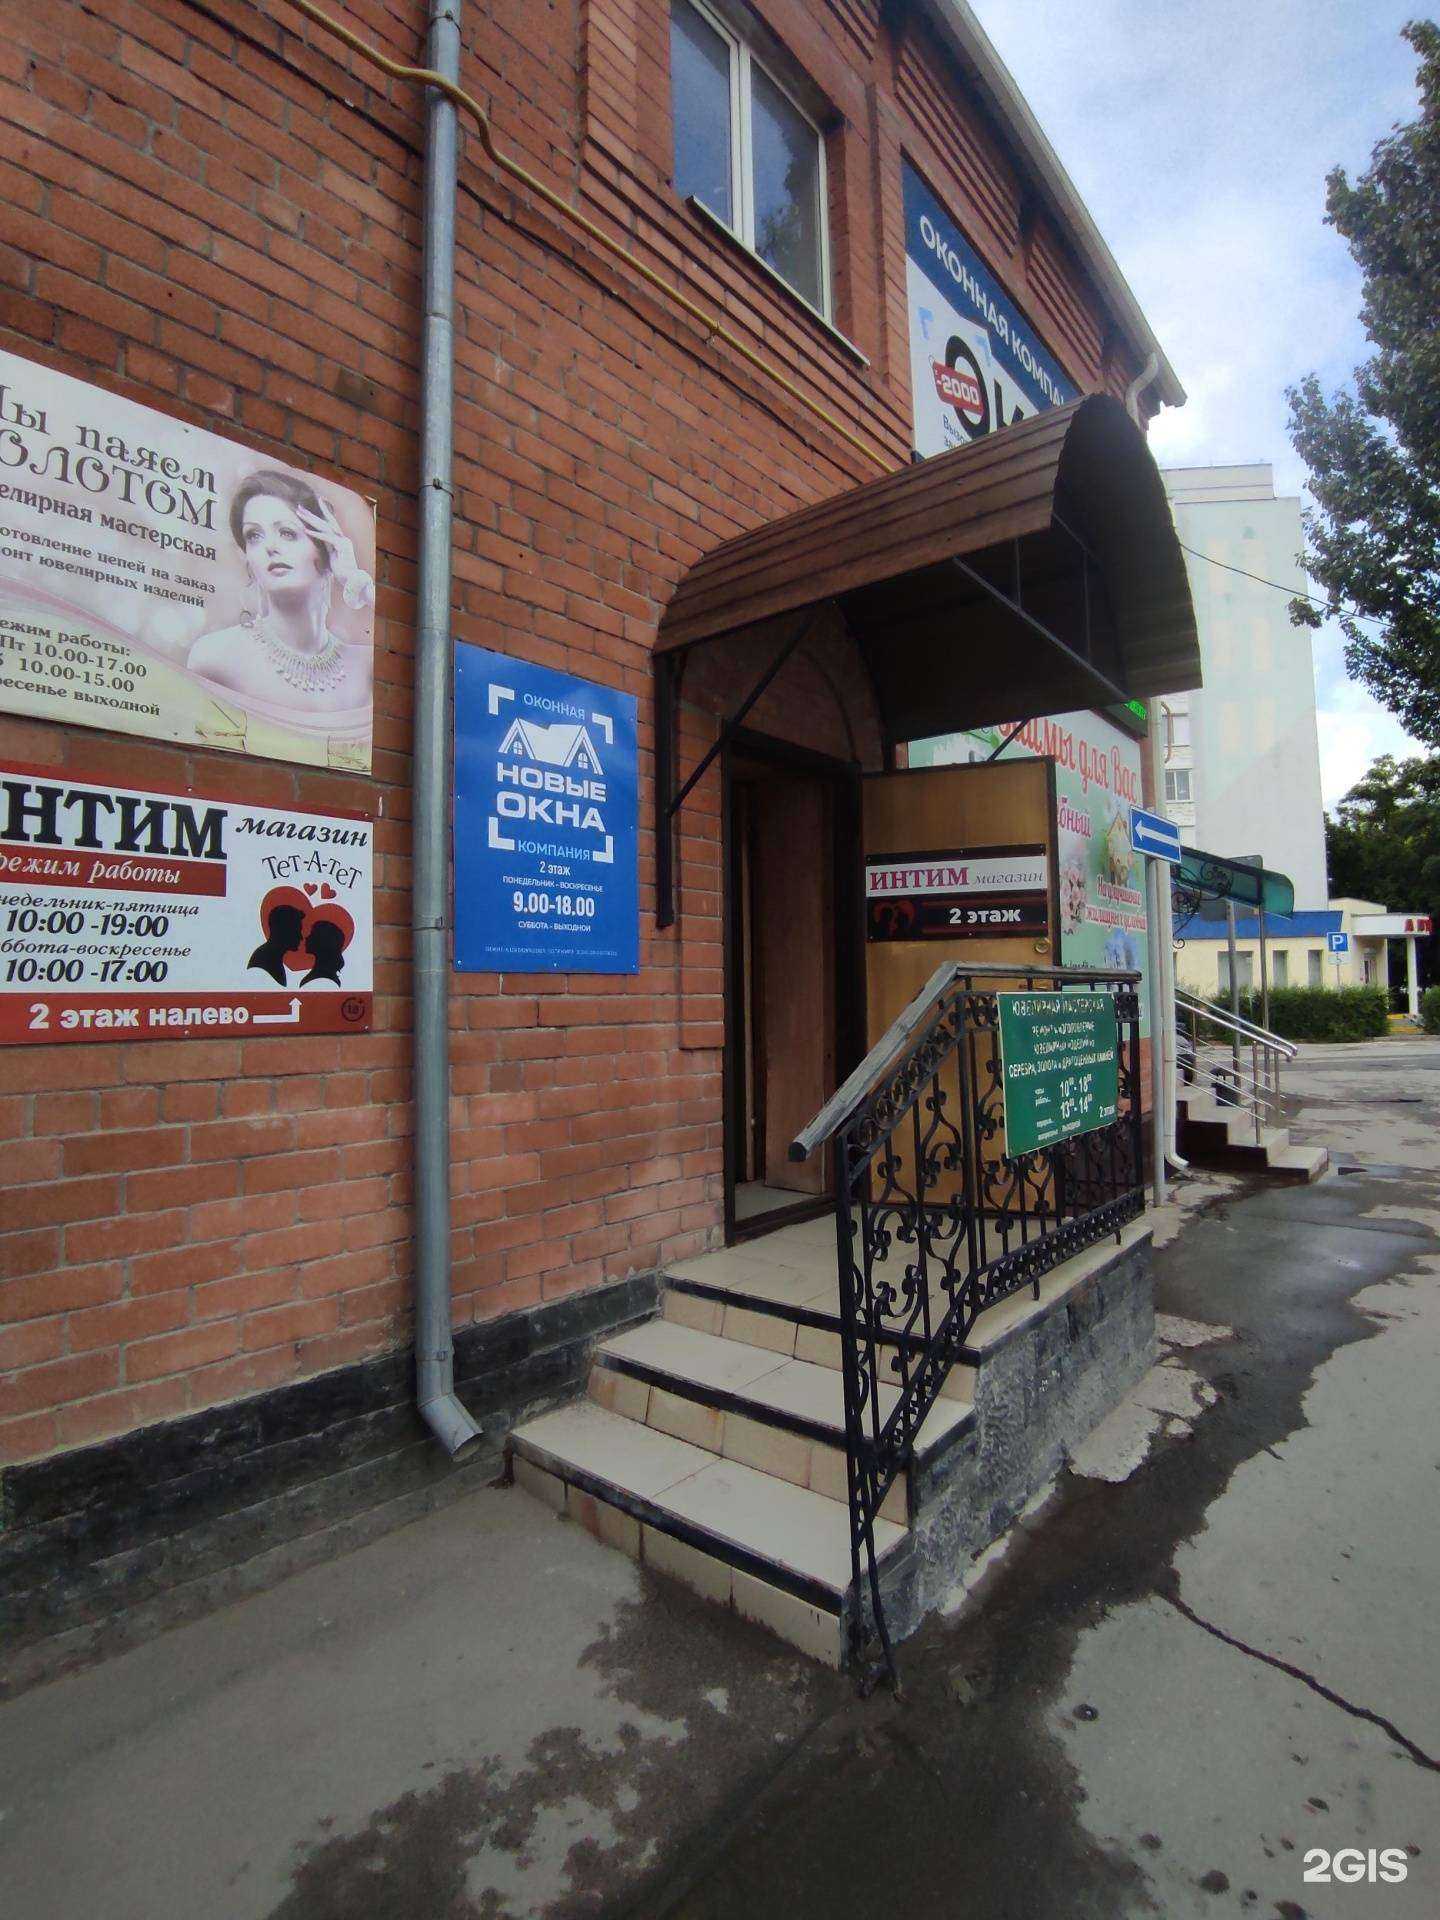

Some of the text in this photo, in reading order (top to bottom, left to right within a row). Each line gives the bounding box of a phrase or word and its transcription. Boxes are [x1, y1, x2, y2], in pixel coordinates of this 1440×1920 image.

[919, 215, 1009, 347] ОКОННАЯ
[0, 384, 217, 494] ы паяем
[100, 513, 216, 561] мастерская
[39, 556, 138, 590] ювелирных
[143, 584, 206, 608] изделий
[97, 550, 146, 574] цепей
[151, 566, 169, 581] на
[174, 574, 216, 594] заказ
[58, 632, 131, 656] работы:
[34, 642, 147, 677] 10.00-17.00
[19, 658, 135, 693] 10.00-15.00
[0, 678, 160, 716] есенье выходной
[523, 693, 585, 720] ОКОННАЯ
[496, 762, 607, 802] НОВЫЕ
[496, 790, 606, 833] ОКНА
[235, 817, 368, 847] магазин
[518, 839, 590, 861] КОМПАНИЯ
[87, 860, 182, 884] работы
[502, 876, 555, 888] ПОНЕДЕЛЬНИК
[539, 861, 571, 876] 2 этаж
[870, 867, 1043, 891] ИНТИМ магазин
[513, 891, 595, 917] 9.00-18.00
[950, 907, 1021, 925] 2 этаж
[7, 909, 84, 934] 10:00
[6, 958, 84, 982] 10:00
[28, 1003, 249, 1030] 2 этаж налево
